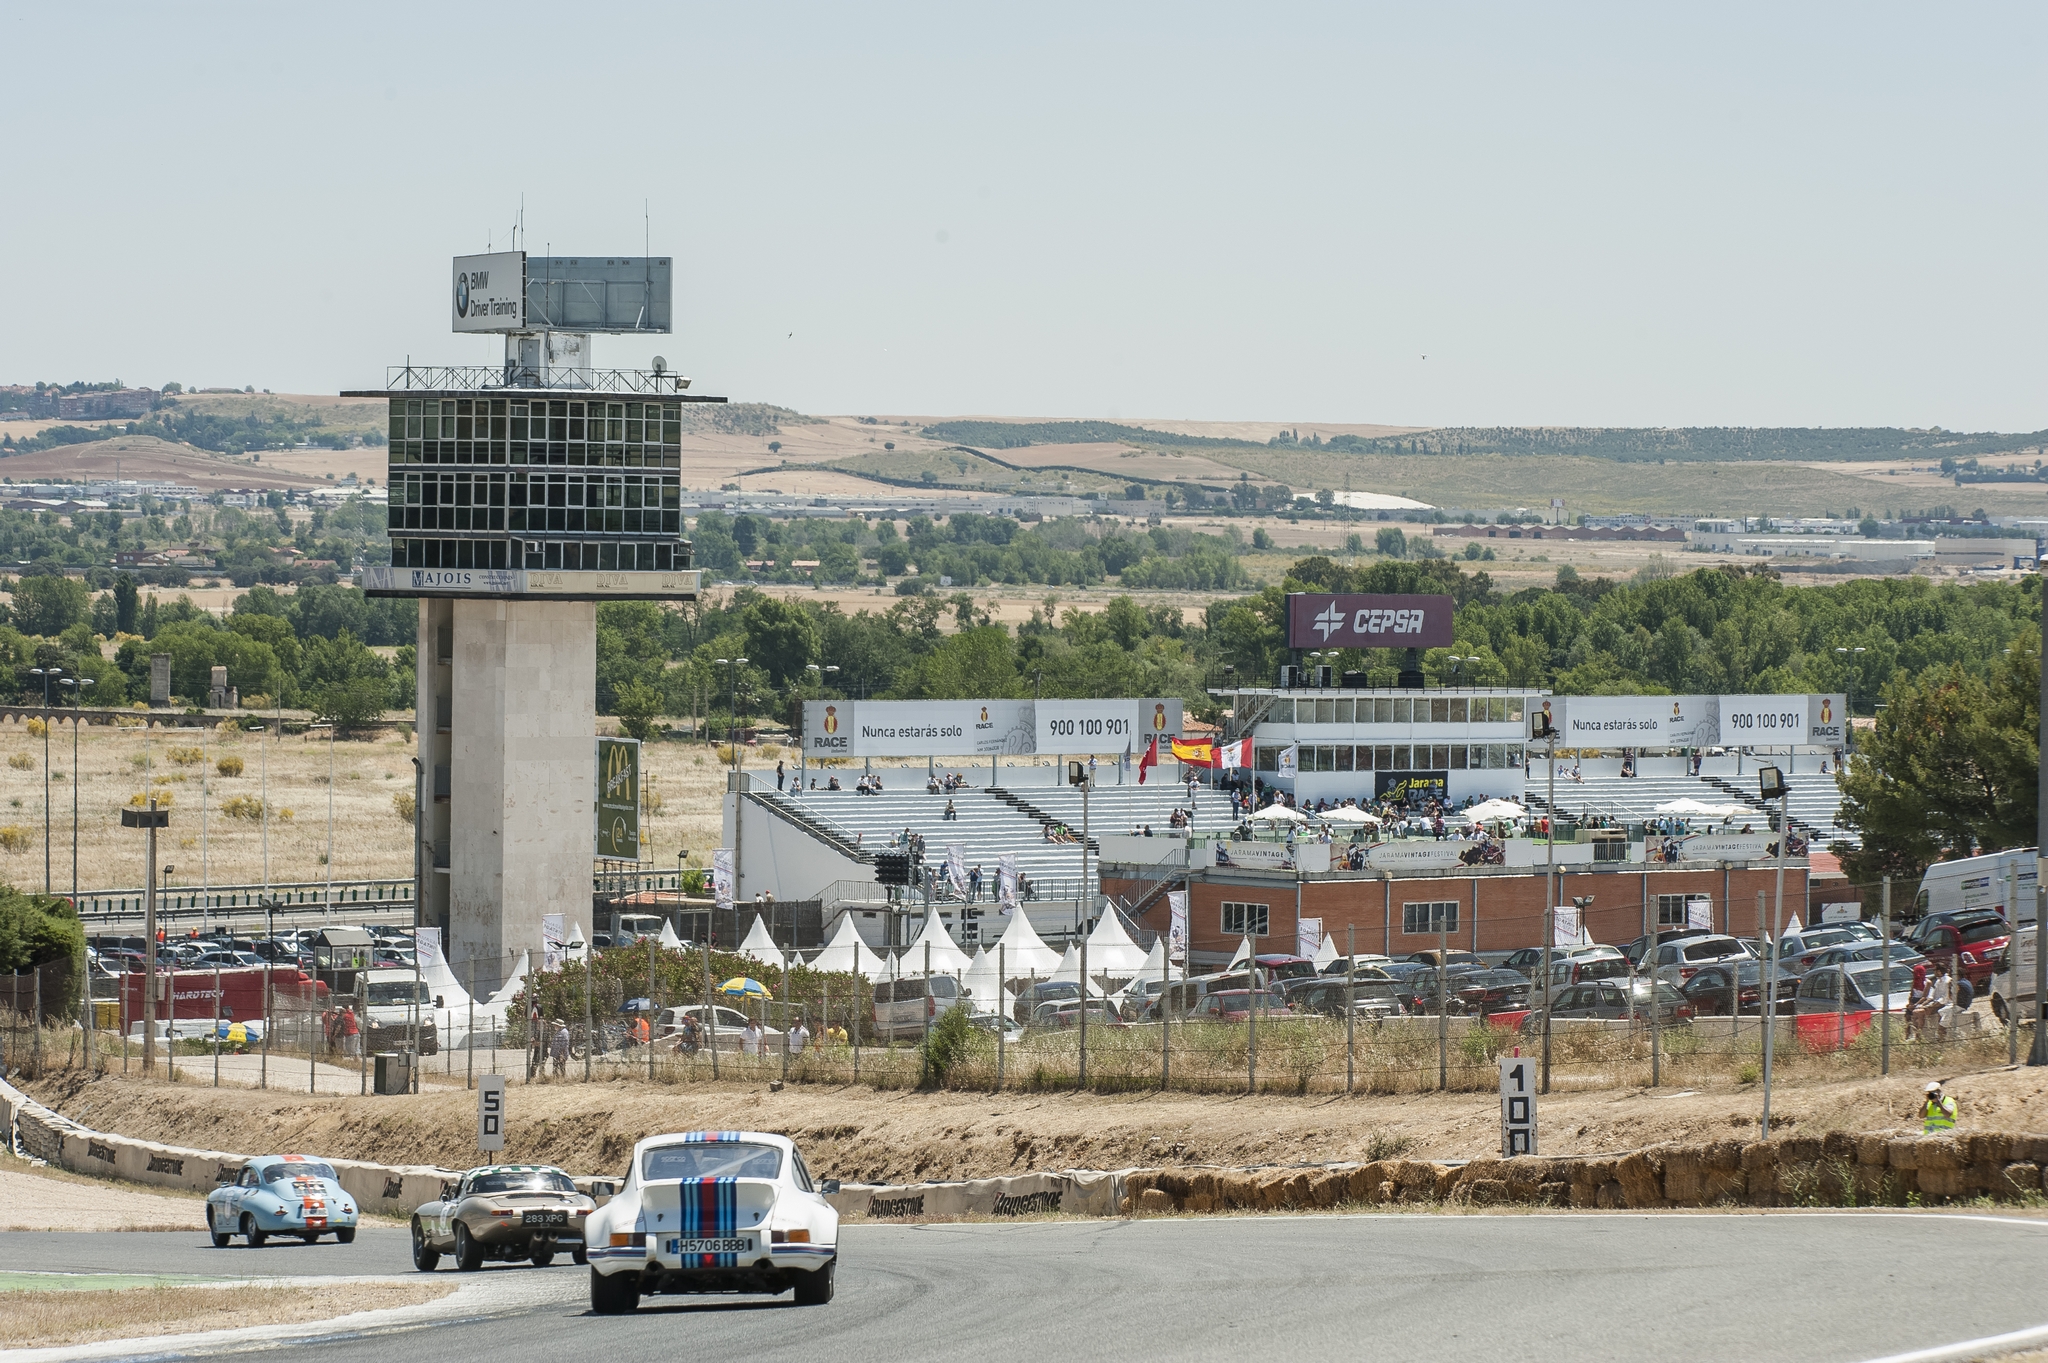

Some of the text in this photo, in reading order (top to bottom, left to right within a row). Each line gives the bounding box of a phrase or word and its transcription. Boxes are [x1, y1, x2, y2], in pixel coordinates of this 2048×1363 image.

[471, 271, 489, 290] BMW
[471, 297, 517, 319] Driver Training
[530, 573, 563, 584] DIVA
[596, 573, 628, 585] DIVA
[662, 574, 693, 585] DIVA
[1353, 609, 1424, 633] CEPSA
[1050, 718, 1128, 735] 900 100 901
[1573, 718, 1657, 730] Nunca estarás solo
[1732, 713, 1799, 728] 900 100 901
[862, 724, 962, 738] Nunca estarás solo
[1812, 726, 1839, 736] RACE
[814, 737, 847, 748] RACE
[525, 1214, 563, 1223] 283 XPG
